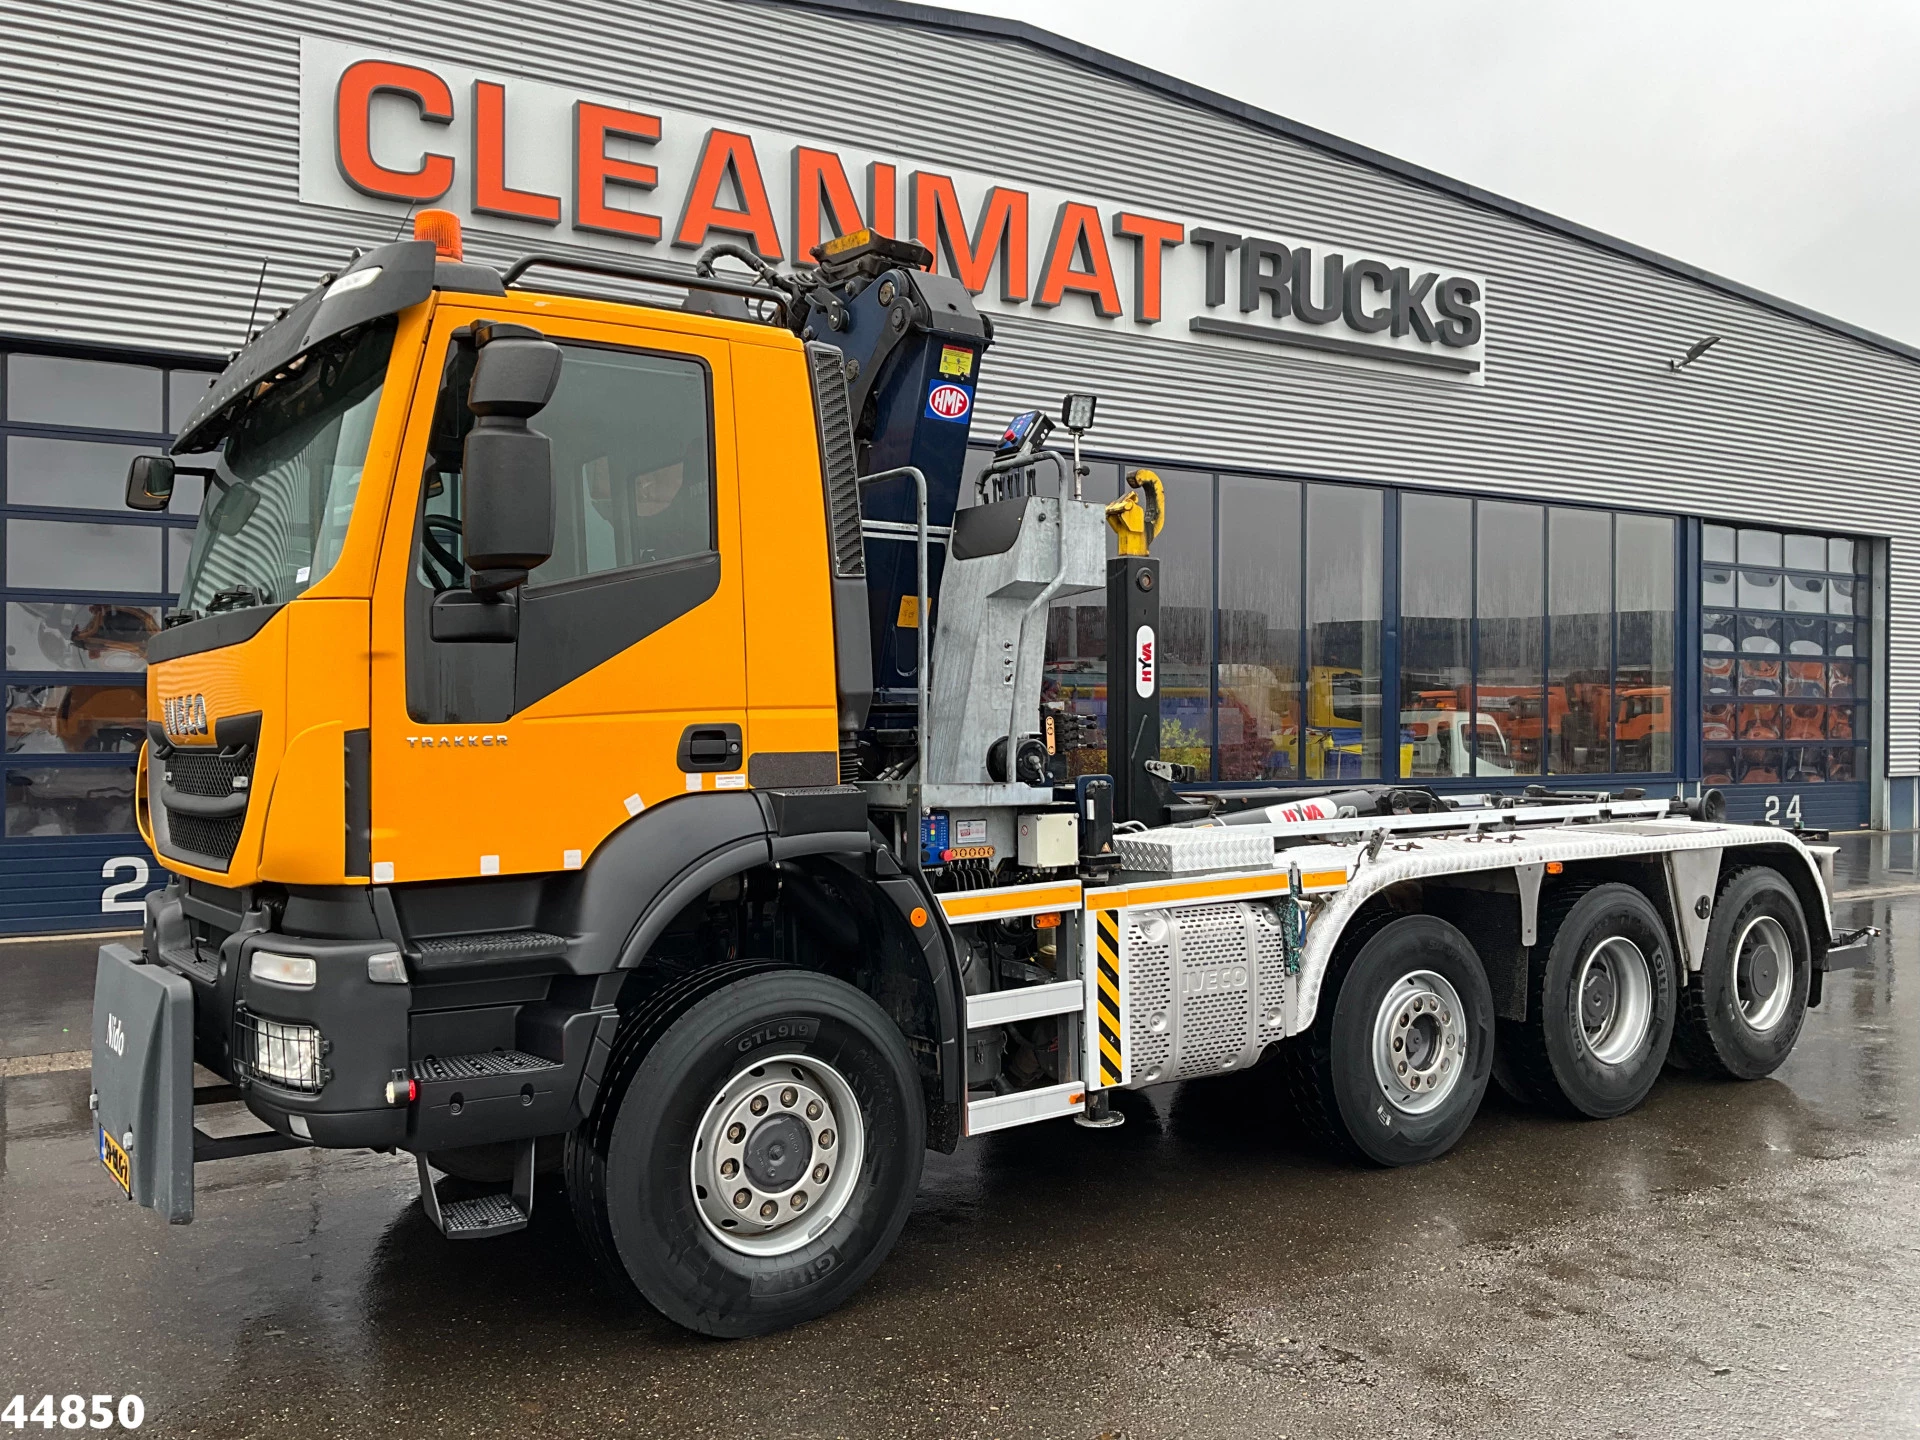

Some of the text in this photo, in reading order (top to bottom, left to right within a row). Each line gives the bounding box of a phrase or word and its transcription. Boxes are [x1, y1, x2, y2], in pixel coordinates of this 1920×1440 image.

[334, 59, 1481, 348] CLEANMAT TRUCKS
[934, 389, 965, 414] HMF
[1138, 642, 1152, 682] HYVA
[165, 693, 208, 735] IVECO
[406, 735, 509, 748] TRAKKER
[1281, 803, 1325, 822] HYVA
[1765, 795, 1802, 825] 24
[1182, 966, 1247, 993] IVECO
[106, 1012, 125, 1057] Nido
[737, 1024, 809, 1052] GTL919
